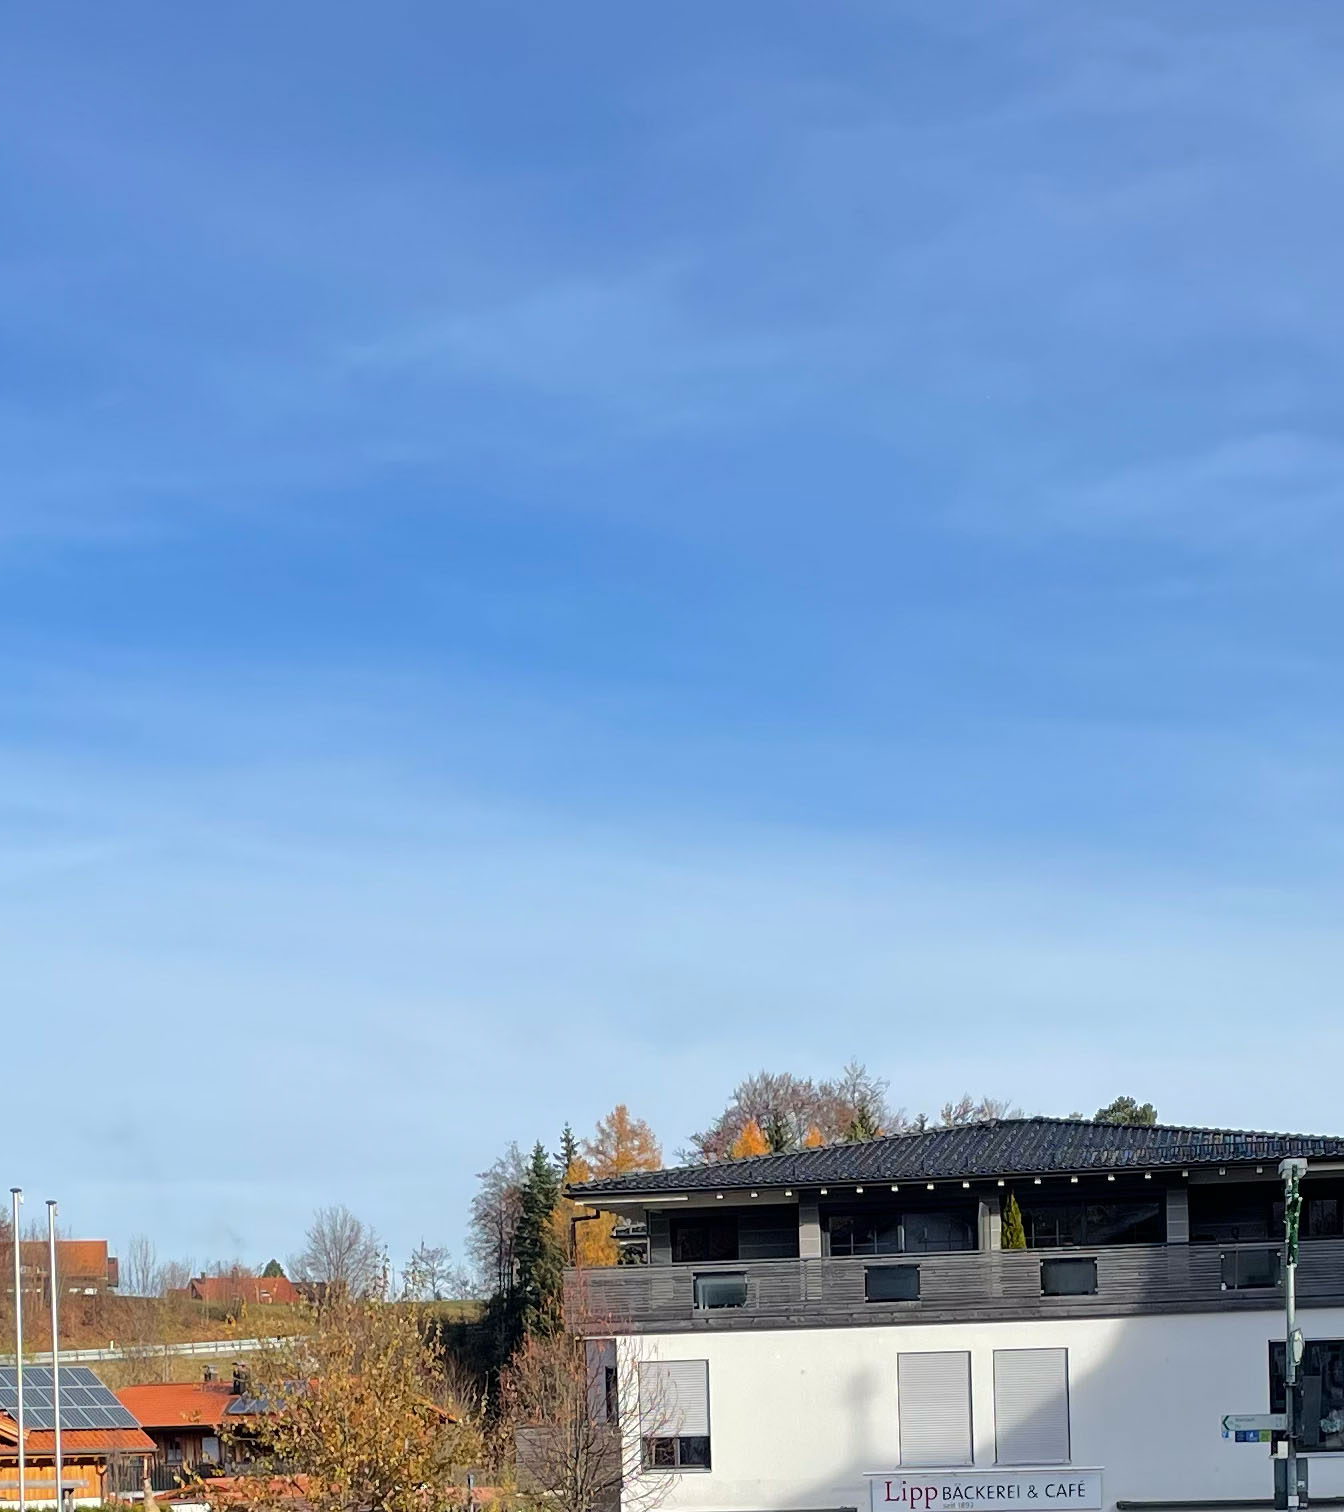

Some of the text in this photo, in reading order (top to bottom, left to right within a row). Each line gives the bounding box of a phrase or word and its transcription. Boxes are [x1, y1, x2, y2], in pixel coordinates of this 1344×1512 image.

[884, 1480, 1086, 1509] Lipp BÄCKEREI & CAFÉ
